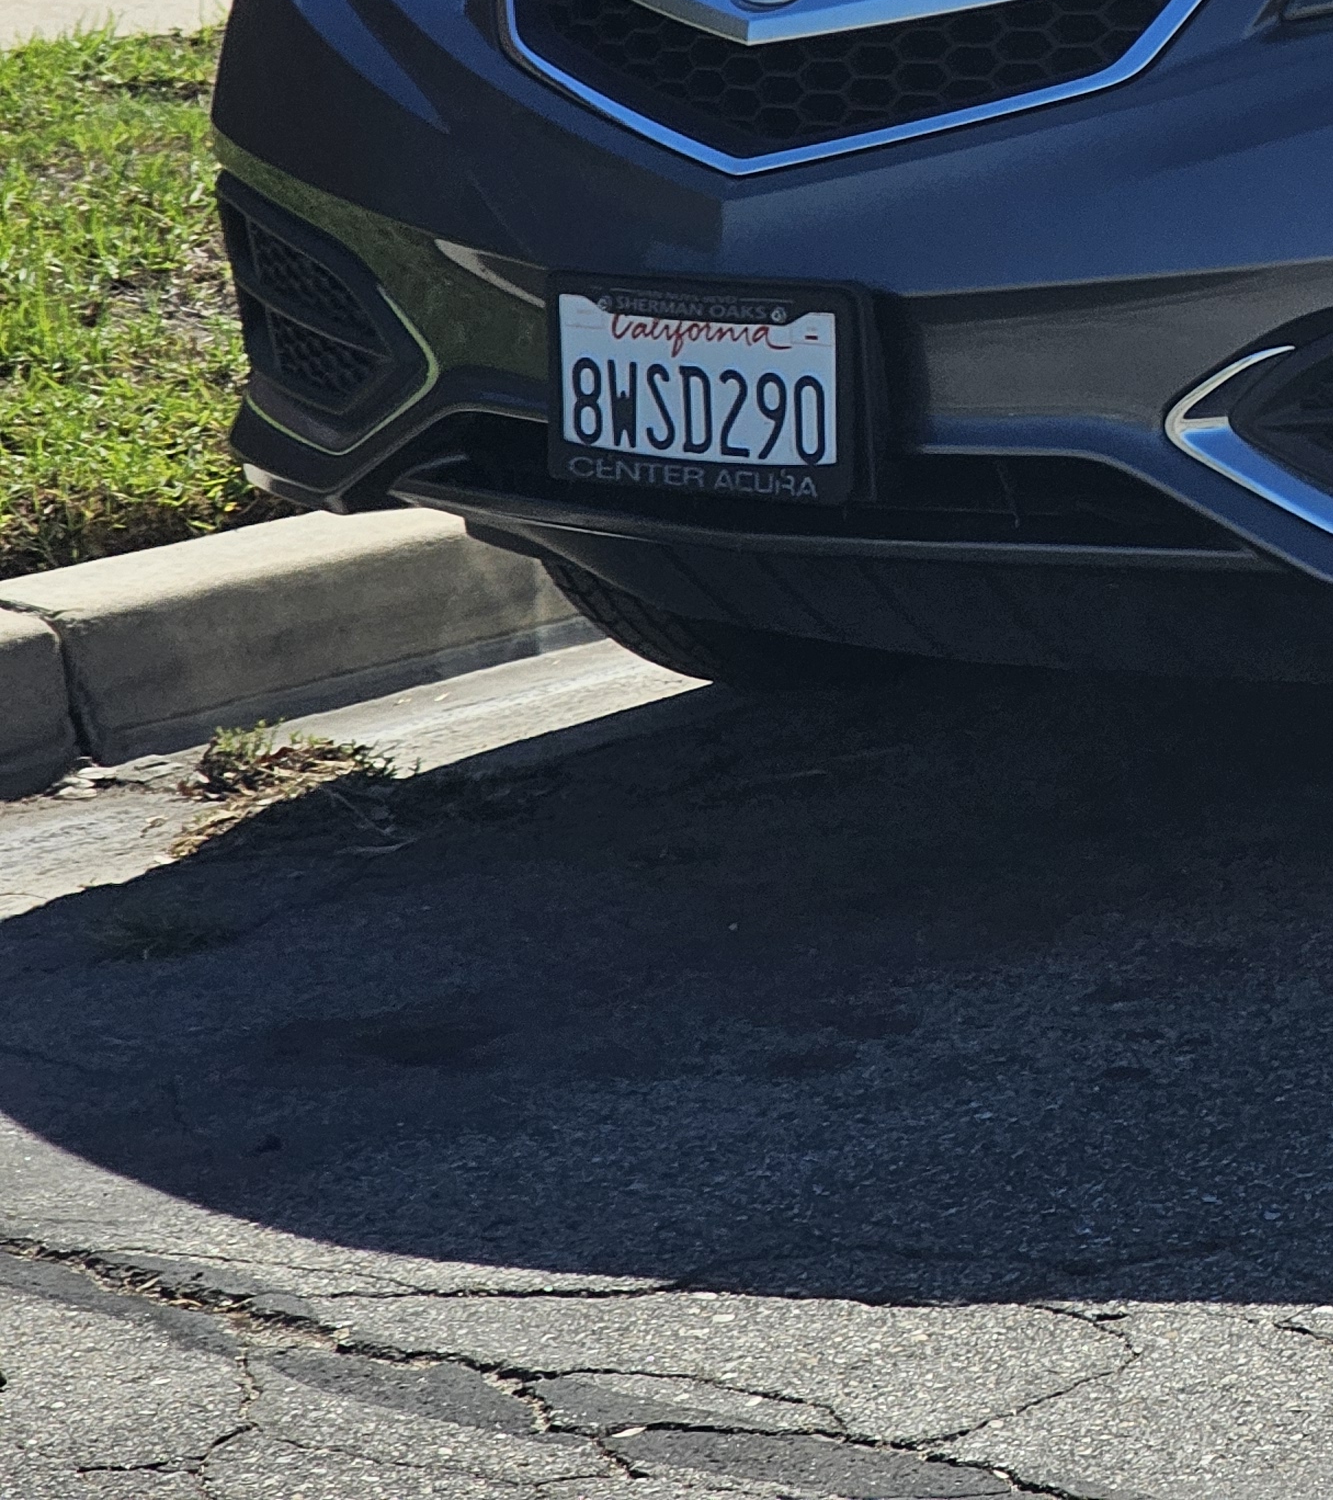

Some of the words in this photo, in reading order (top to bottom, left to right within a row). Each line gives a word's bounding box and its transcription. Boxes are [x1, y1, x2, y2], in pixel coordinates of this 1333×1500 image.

[615, 295, 704, 316] SHERMAN
[708, 304, 768, 320] OAKS
[611, 313, 793, 358] California
[572, 356, 826, 466] 8WSD290
[568, 456, 705, 488] CENTER
[714, 468, 818, 498] ACURA
